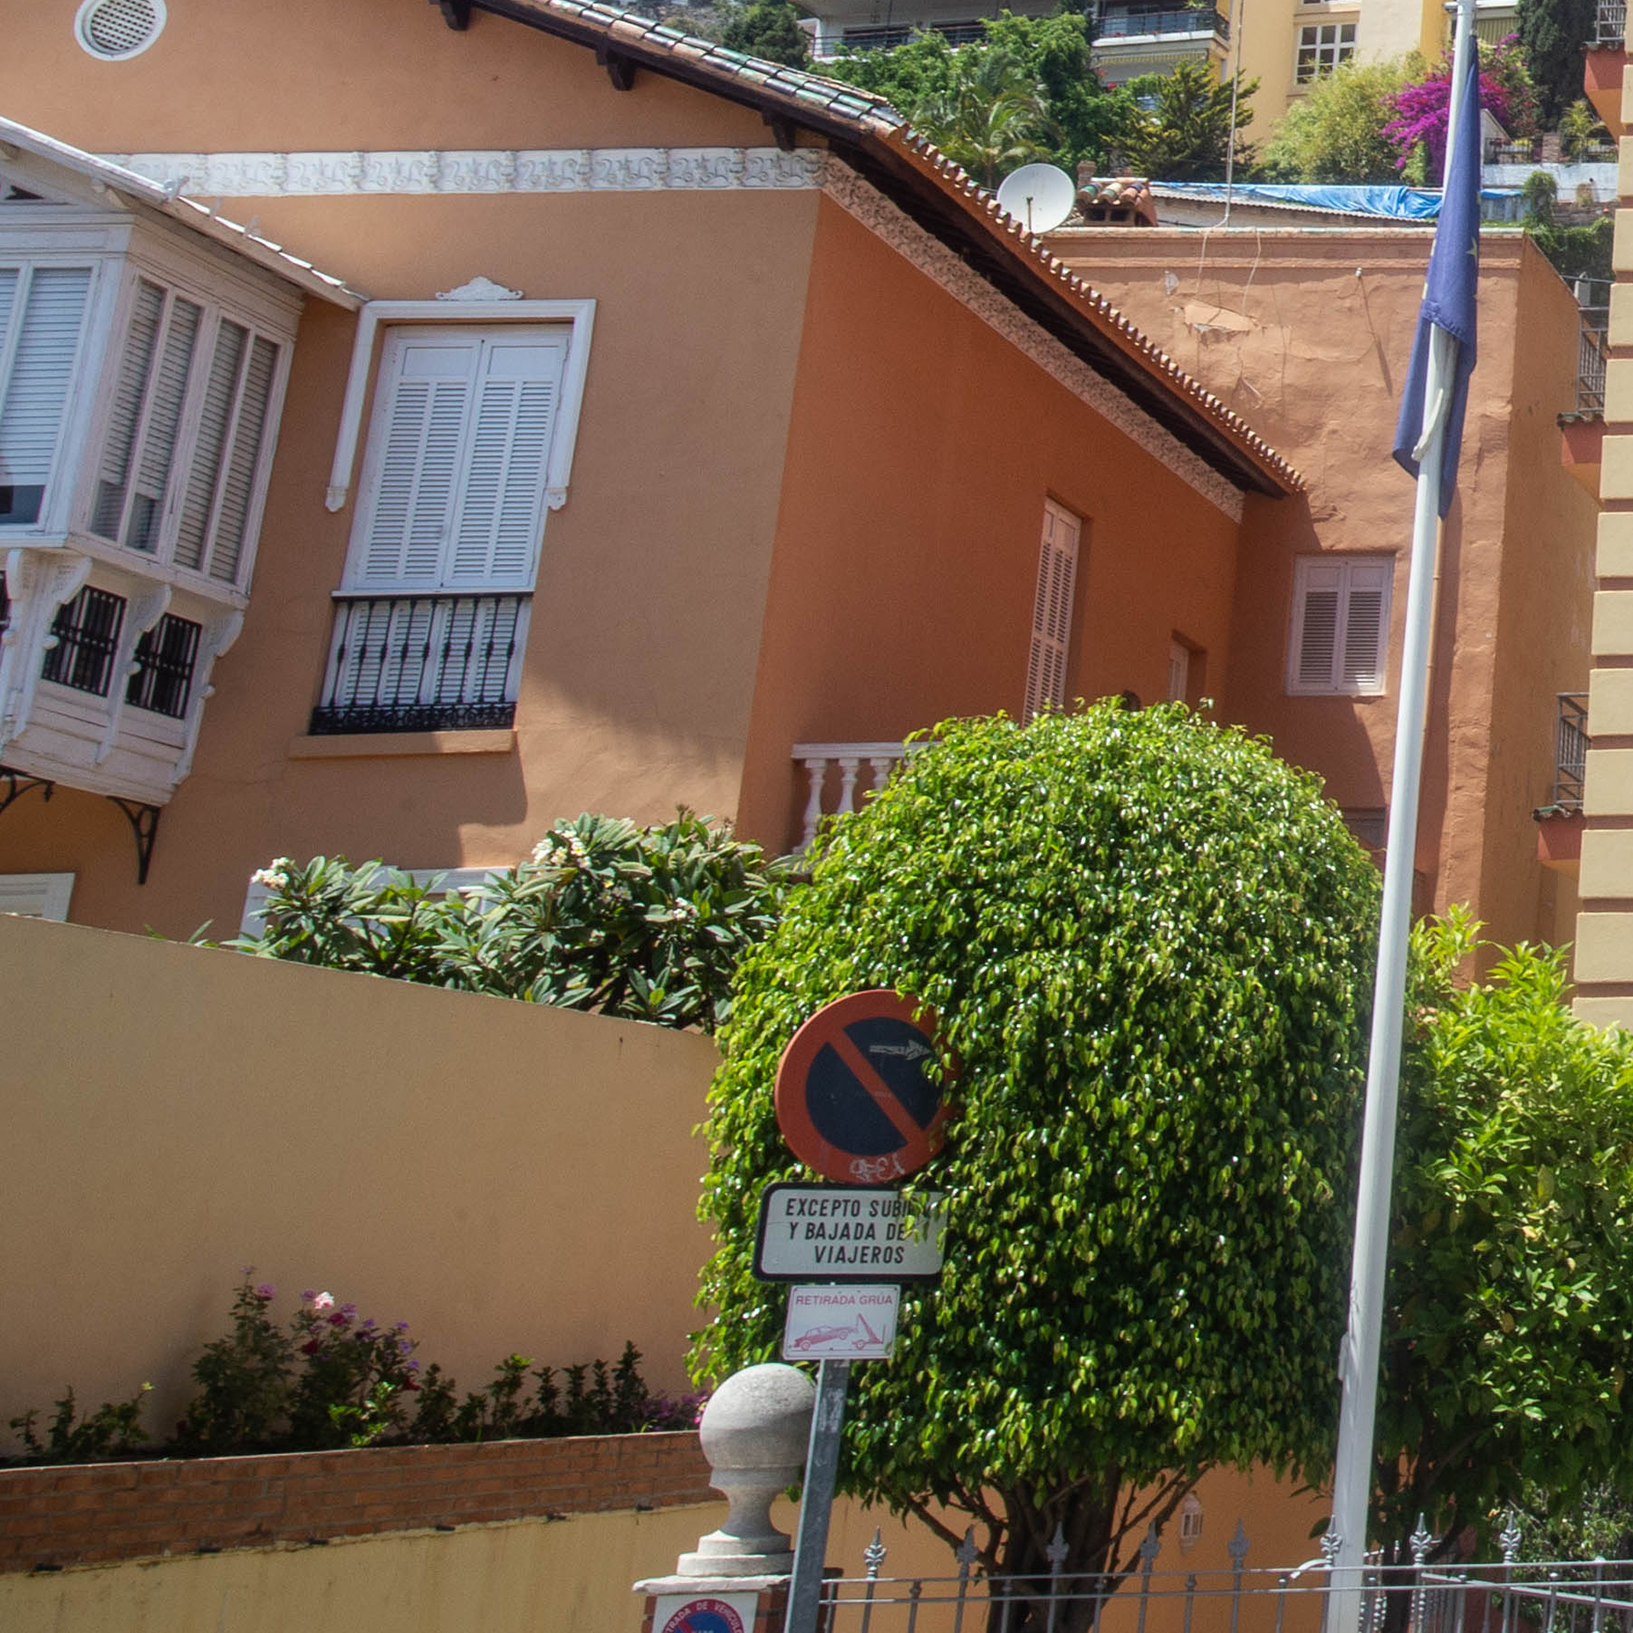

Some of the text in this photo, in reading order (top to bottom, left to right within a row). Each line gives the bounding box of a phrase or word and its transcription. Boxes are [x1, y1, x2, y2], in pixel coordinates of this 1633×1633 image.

[785, 1198, 928, 1218] EXCEPTO SUBI
[788, 1222, 907, 1241] Y BAJADA DE
[815, 1245, 905, 1264] VIAJEROS
[796, 1294, 856, 1306] RETIRADA
[696, 1601, 708, 1610] DE
